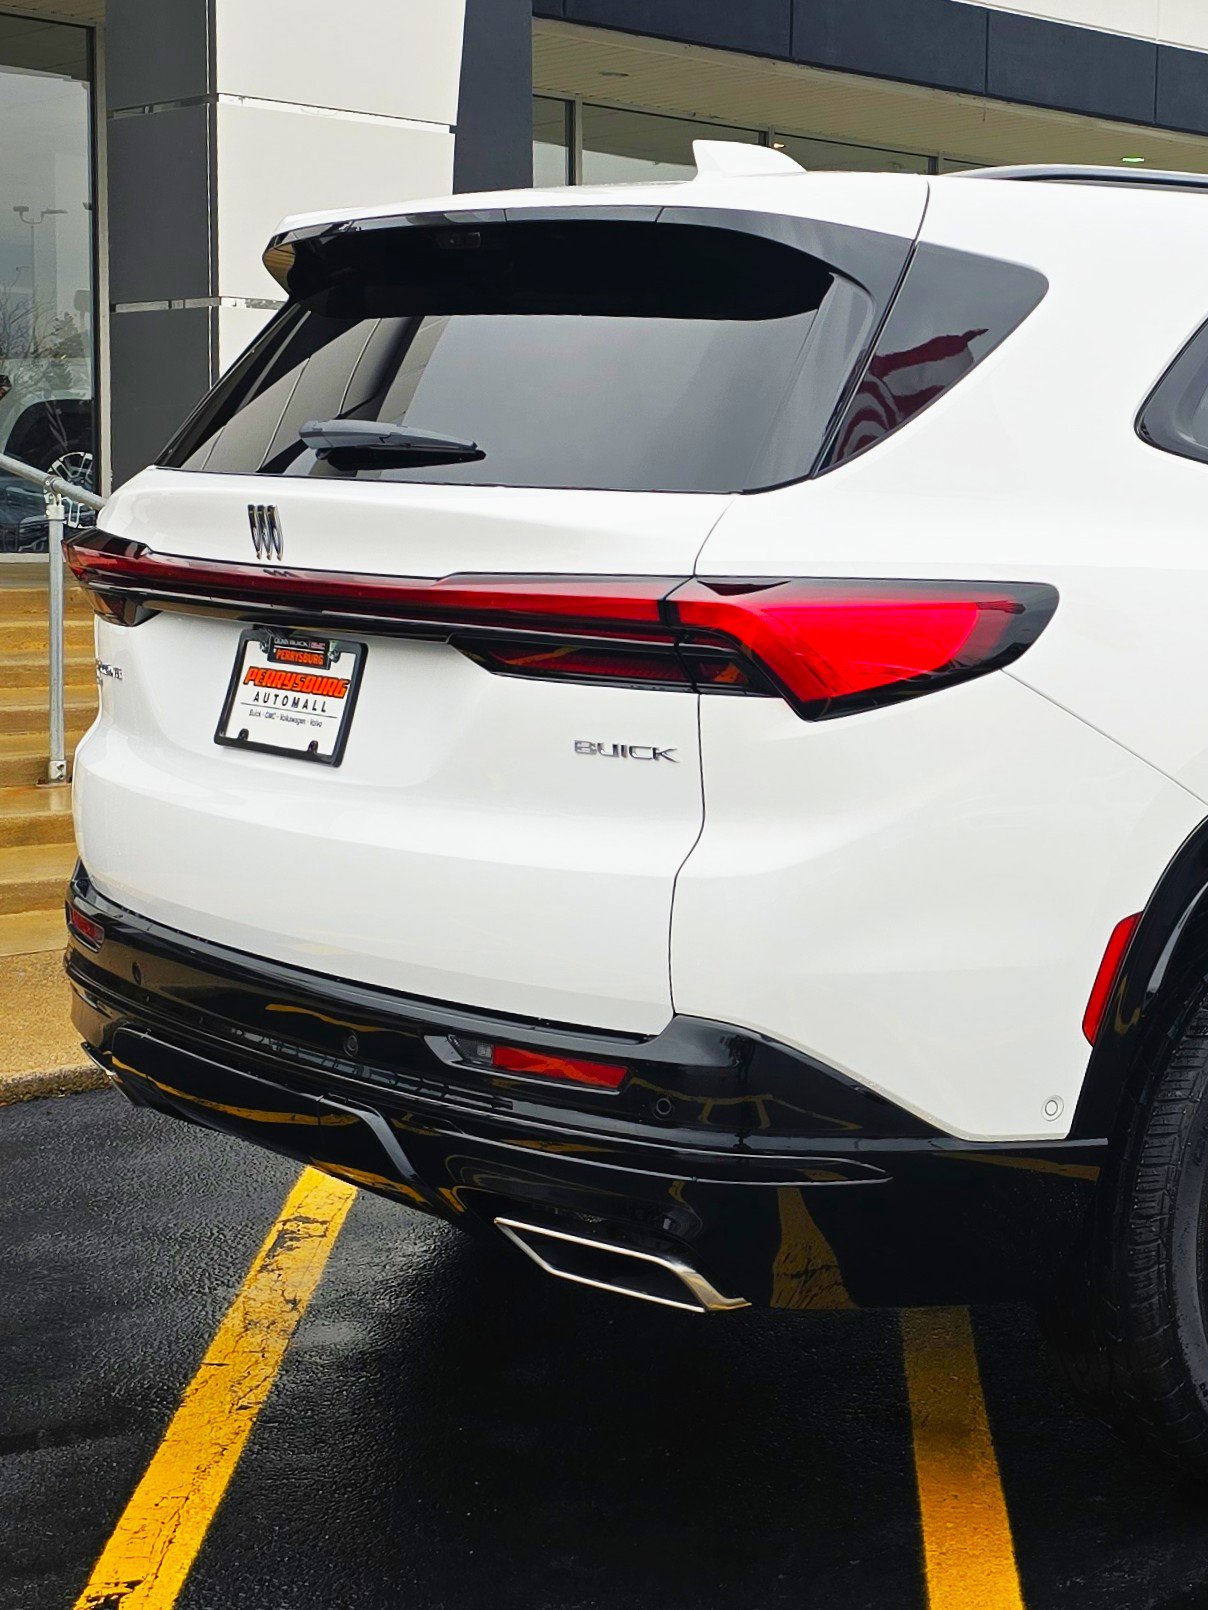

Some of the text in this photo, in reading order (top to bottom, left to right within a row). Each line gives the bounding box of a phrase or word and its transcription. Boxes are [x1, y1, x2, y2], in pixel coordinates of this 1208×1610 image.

[276, 649, 324, 665] PERRYSBURG
[243, 666, 351, 699] PERRYSBURG
[253, 691, 327, 713] AUTOMALL
[574, 740, 680, 763] BUICK
